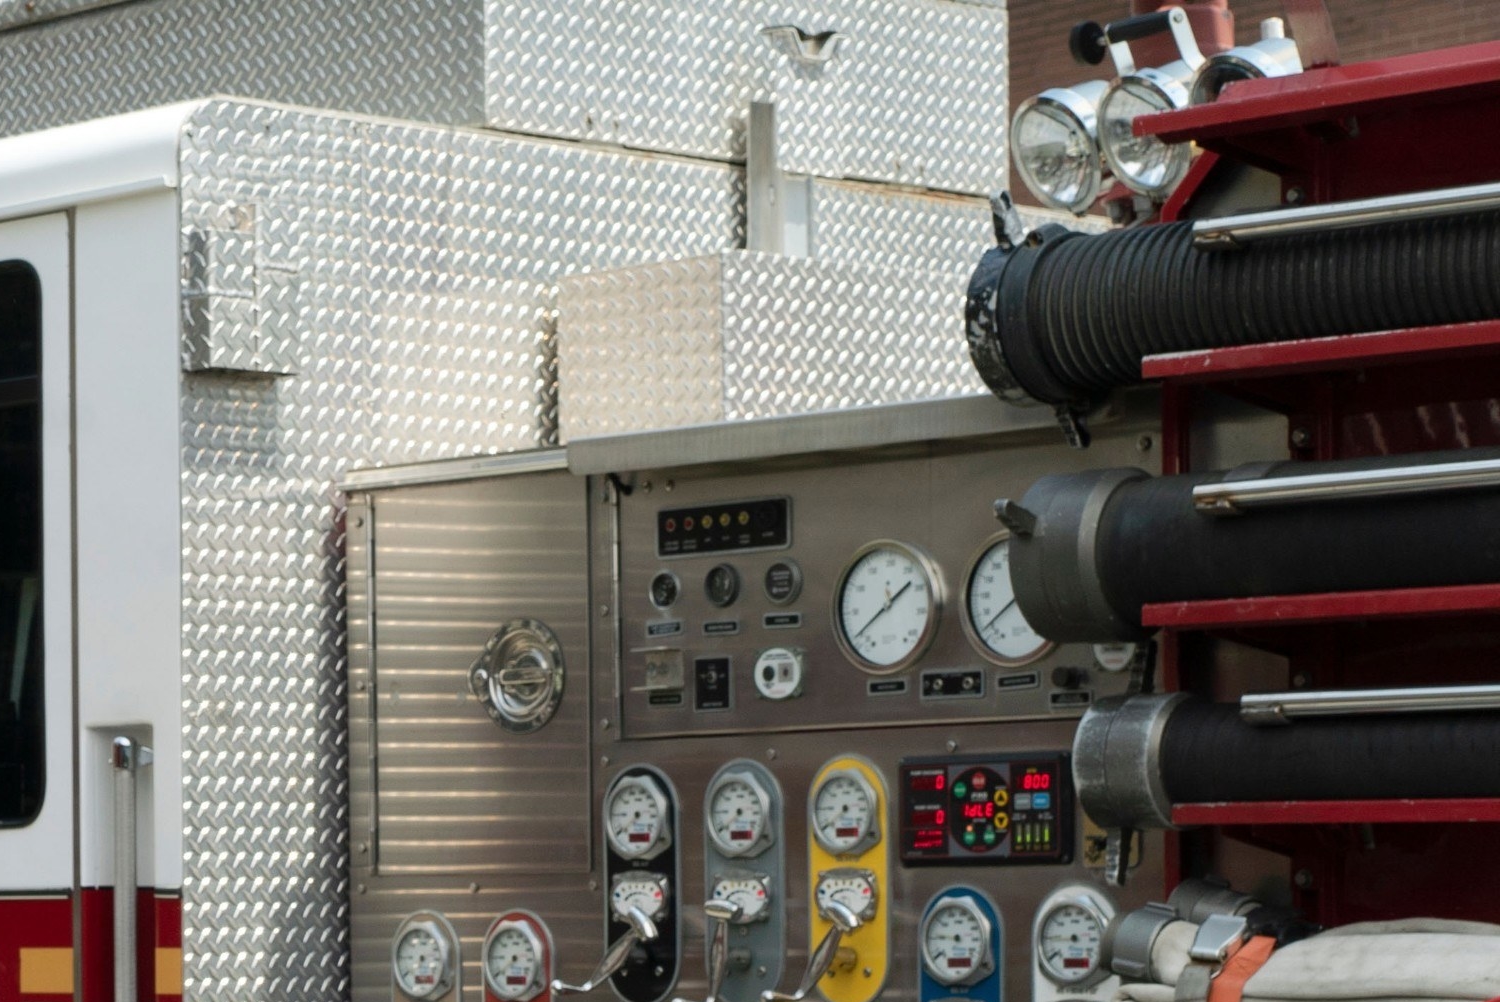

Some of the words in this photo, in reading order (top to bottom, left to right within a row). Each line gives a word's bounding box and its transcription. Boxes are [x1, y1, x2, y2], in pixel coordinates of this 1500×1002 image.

[936, 775, 945, 790] 0
[1024, 774, 1050, 789] 800
[936, 810, 945, 825] 0
